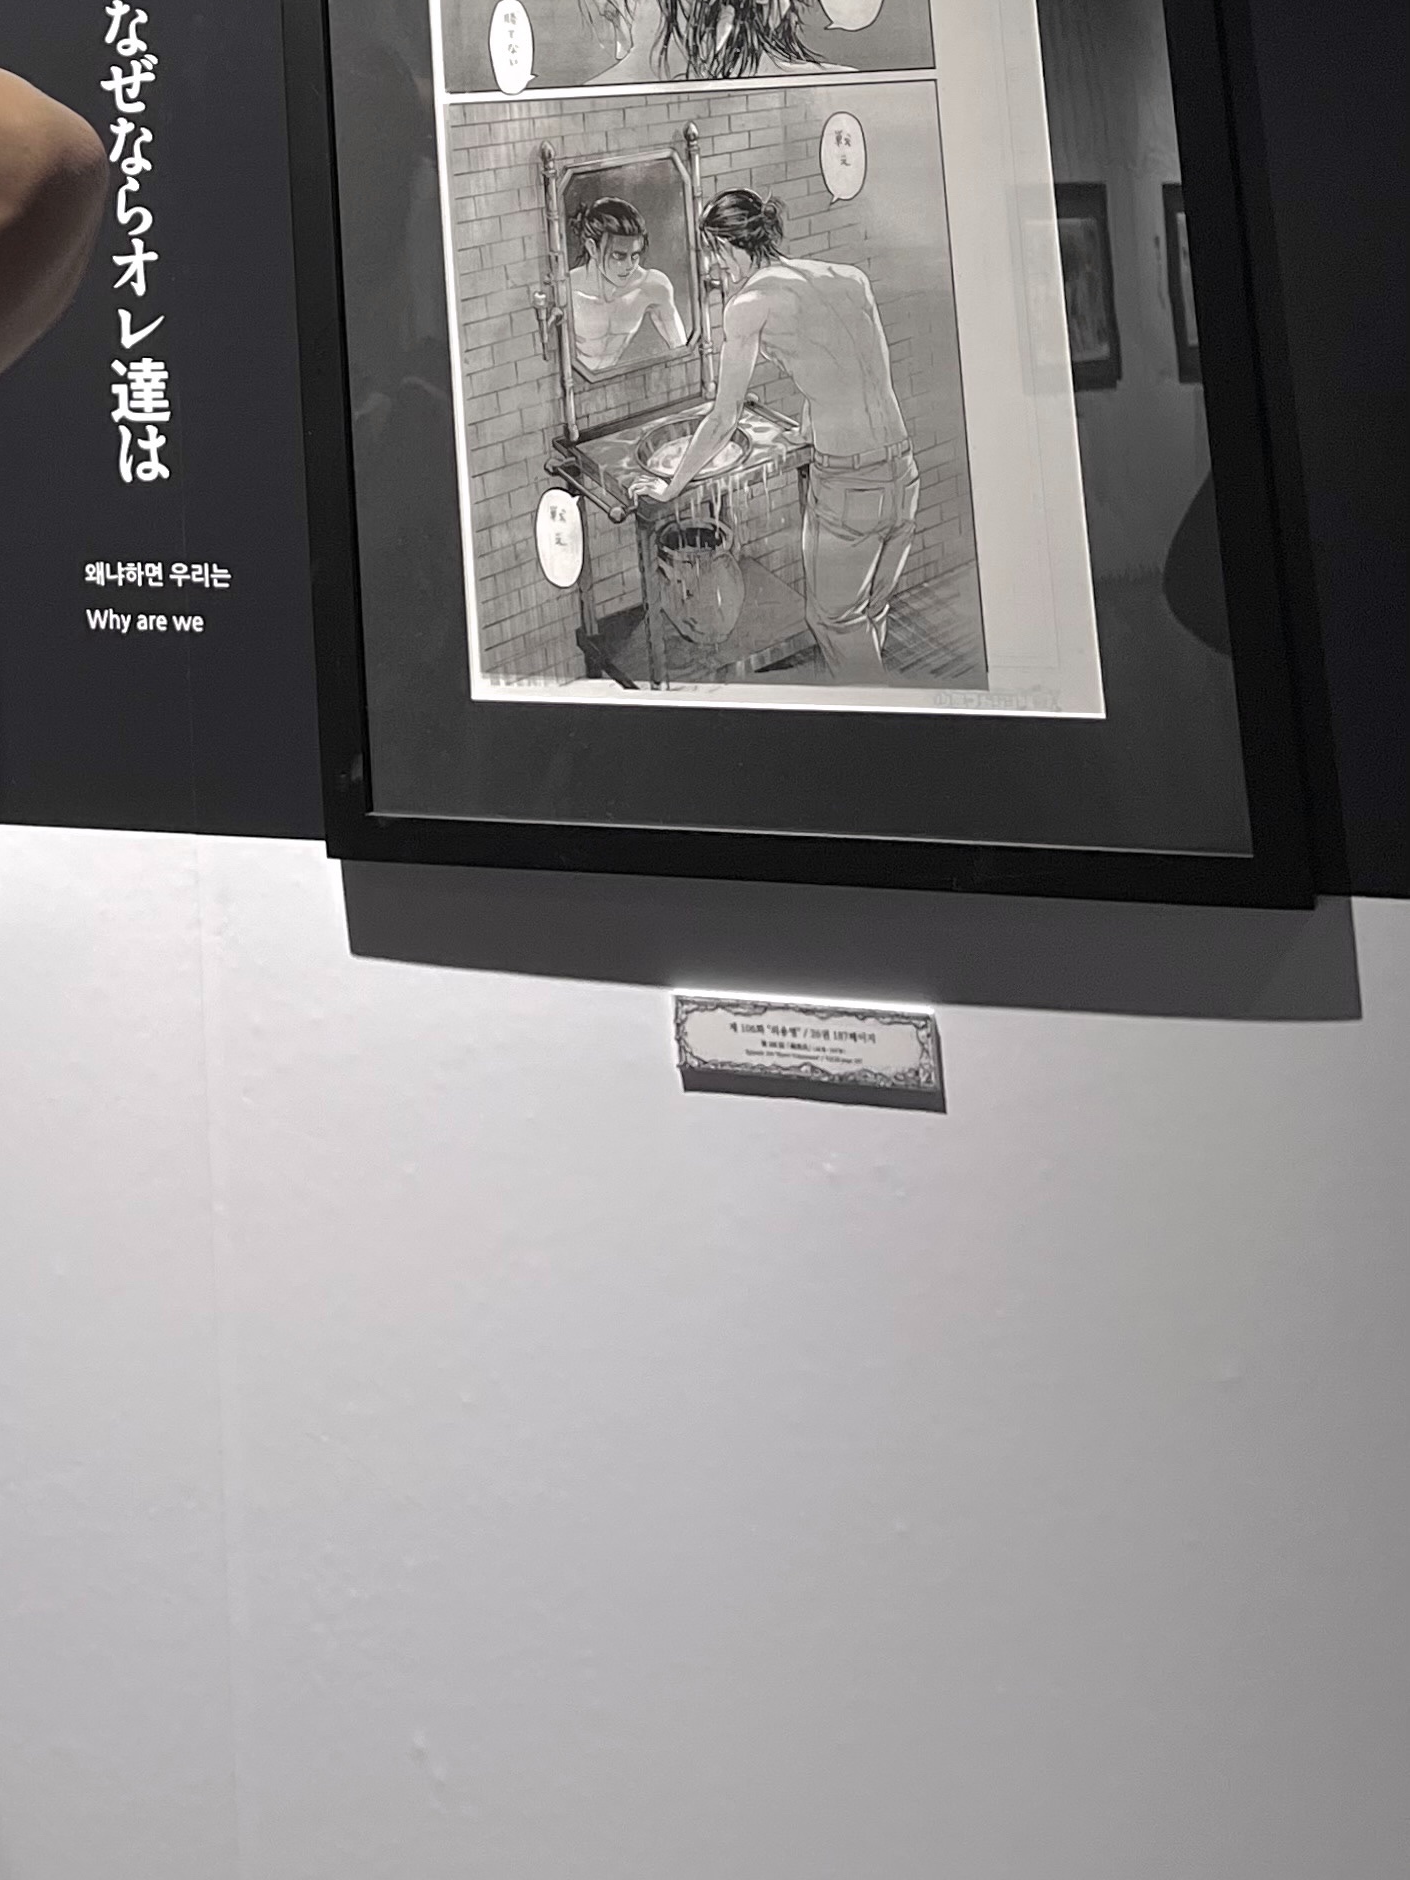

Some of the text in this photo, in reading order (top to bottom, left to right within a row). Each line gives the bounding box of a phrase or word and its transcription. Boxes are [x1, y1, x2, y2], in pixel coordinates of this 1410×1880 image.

[100, 0, 172, 483] なぜならオレ達は
[85, 561, 232, 588] 왜냐하면 우리는
[86, 608, 204, 634] Why are we
